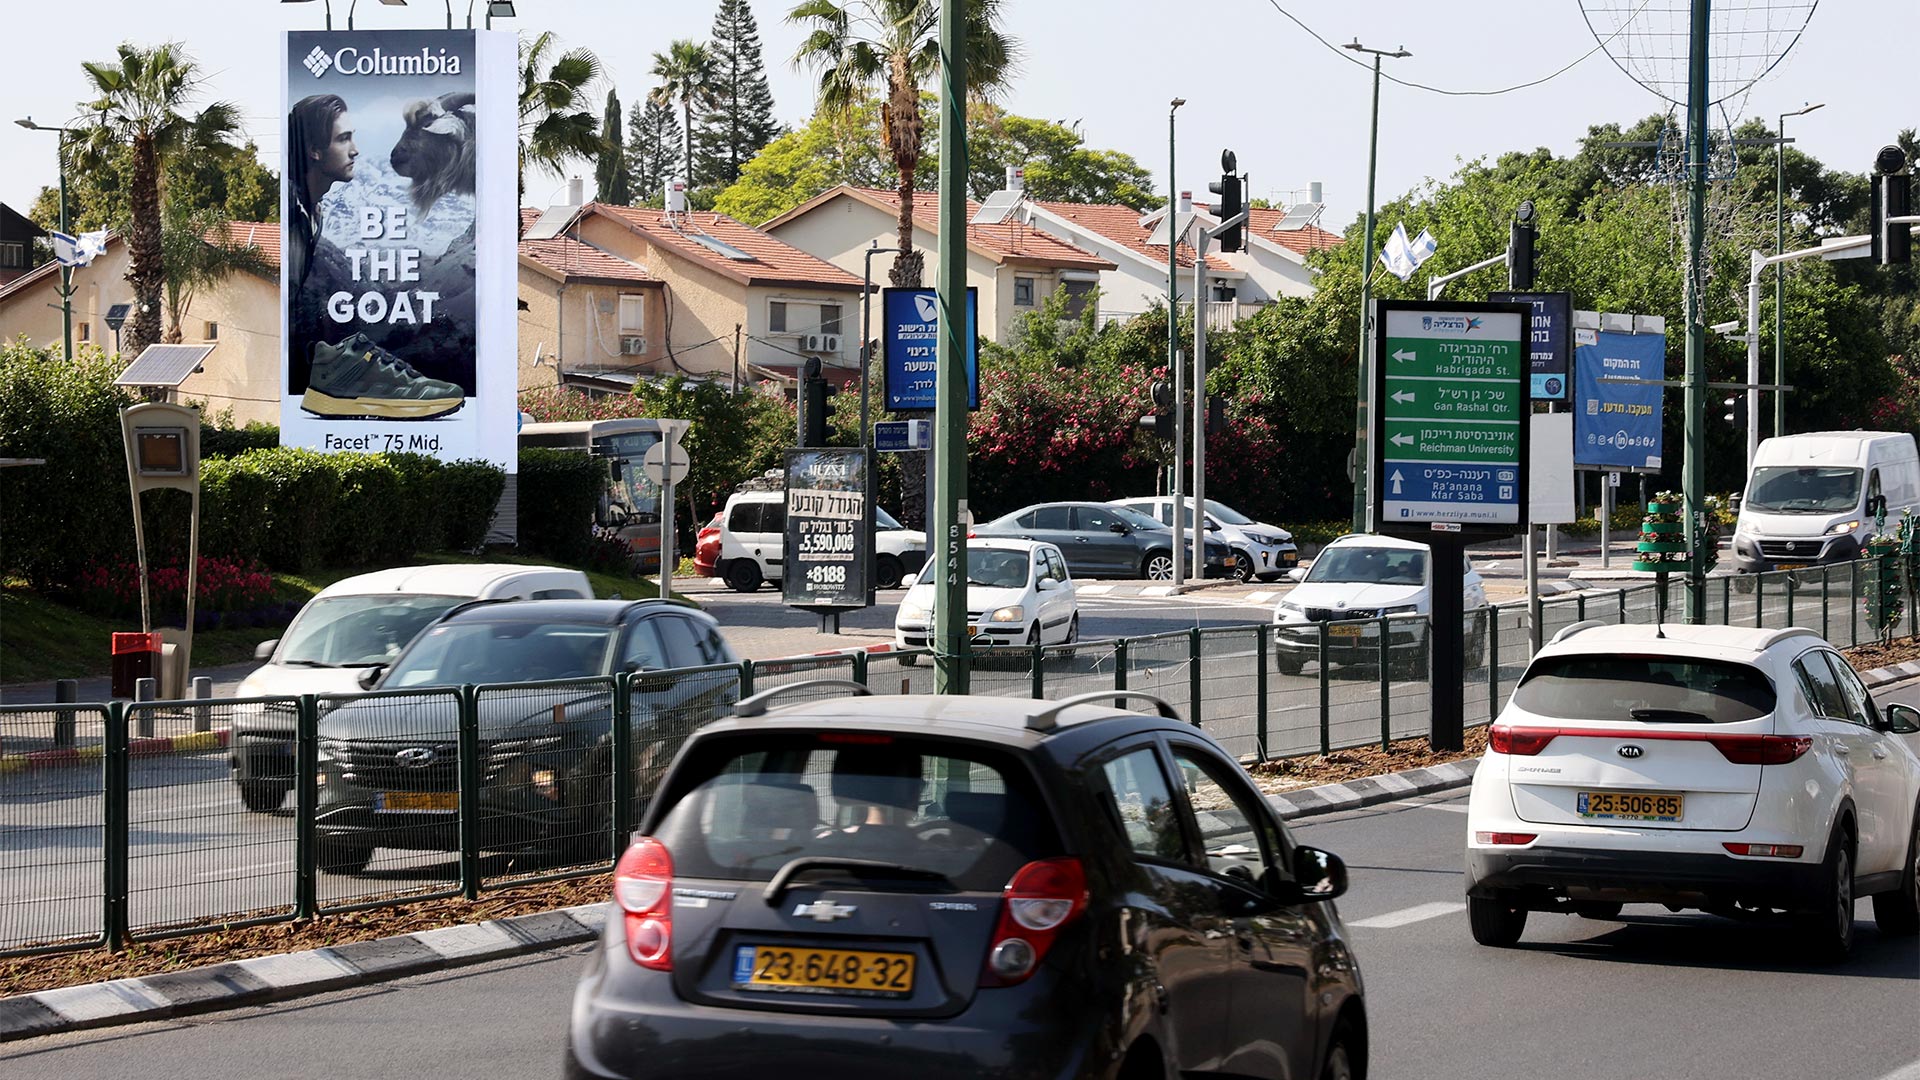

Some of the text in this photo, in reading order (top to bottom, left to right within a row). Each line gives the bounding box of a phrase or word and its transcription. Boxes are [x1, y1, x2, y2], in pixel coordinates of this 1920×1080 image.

[334, 47, 461, 75] Columbia
[362, 206, 407, 239] BE
[346, 249, 420, 281] THE
[327, 290, 440, 324] GOAT
[898, 324, 926, 332] הישוב
[1433, 320, 1464, 328] הרצליה
[907, 346, 929, 357] בינוי
[1439, 343, 1508, 354] רח' הבריגדה
[1452, 355, 1495, 365] היהודית
[1603, 358, 1640, 370] זה המקום
[1435, 364, 1510, 376] Habrigada St.
[1472, 390, 1480, 401] גן
[1484, 390, 1505, 400] שכ'
[1433, 402, 1510, 413] Gan Rashal Qtr.
[1420, 429, 1515, 441] אוניברסיטת רייכמן
[384, 434, 404, 451] 75
[409, 434, 443, 451] Mid.
[1419, 442, 1515, 456] Reichman University
[1612, 473, 1617, 483] 3
[1432, 482, 1482, 491] Ra'anana
[1431, 490, 1484, 500] Kfar Saba
[791, 493, 860, 516] הגודל קובע!
[847, 520, 854, 533] 5
[1621, 747, 1640, 756] KIA
